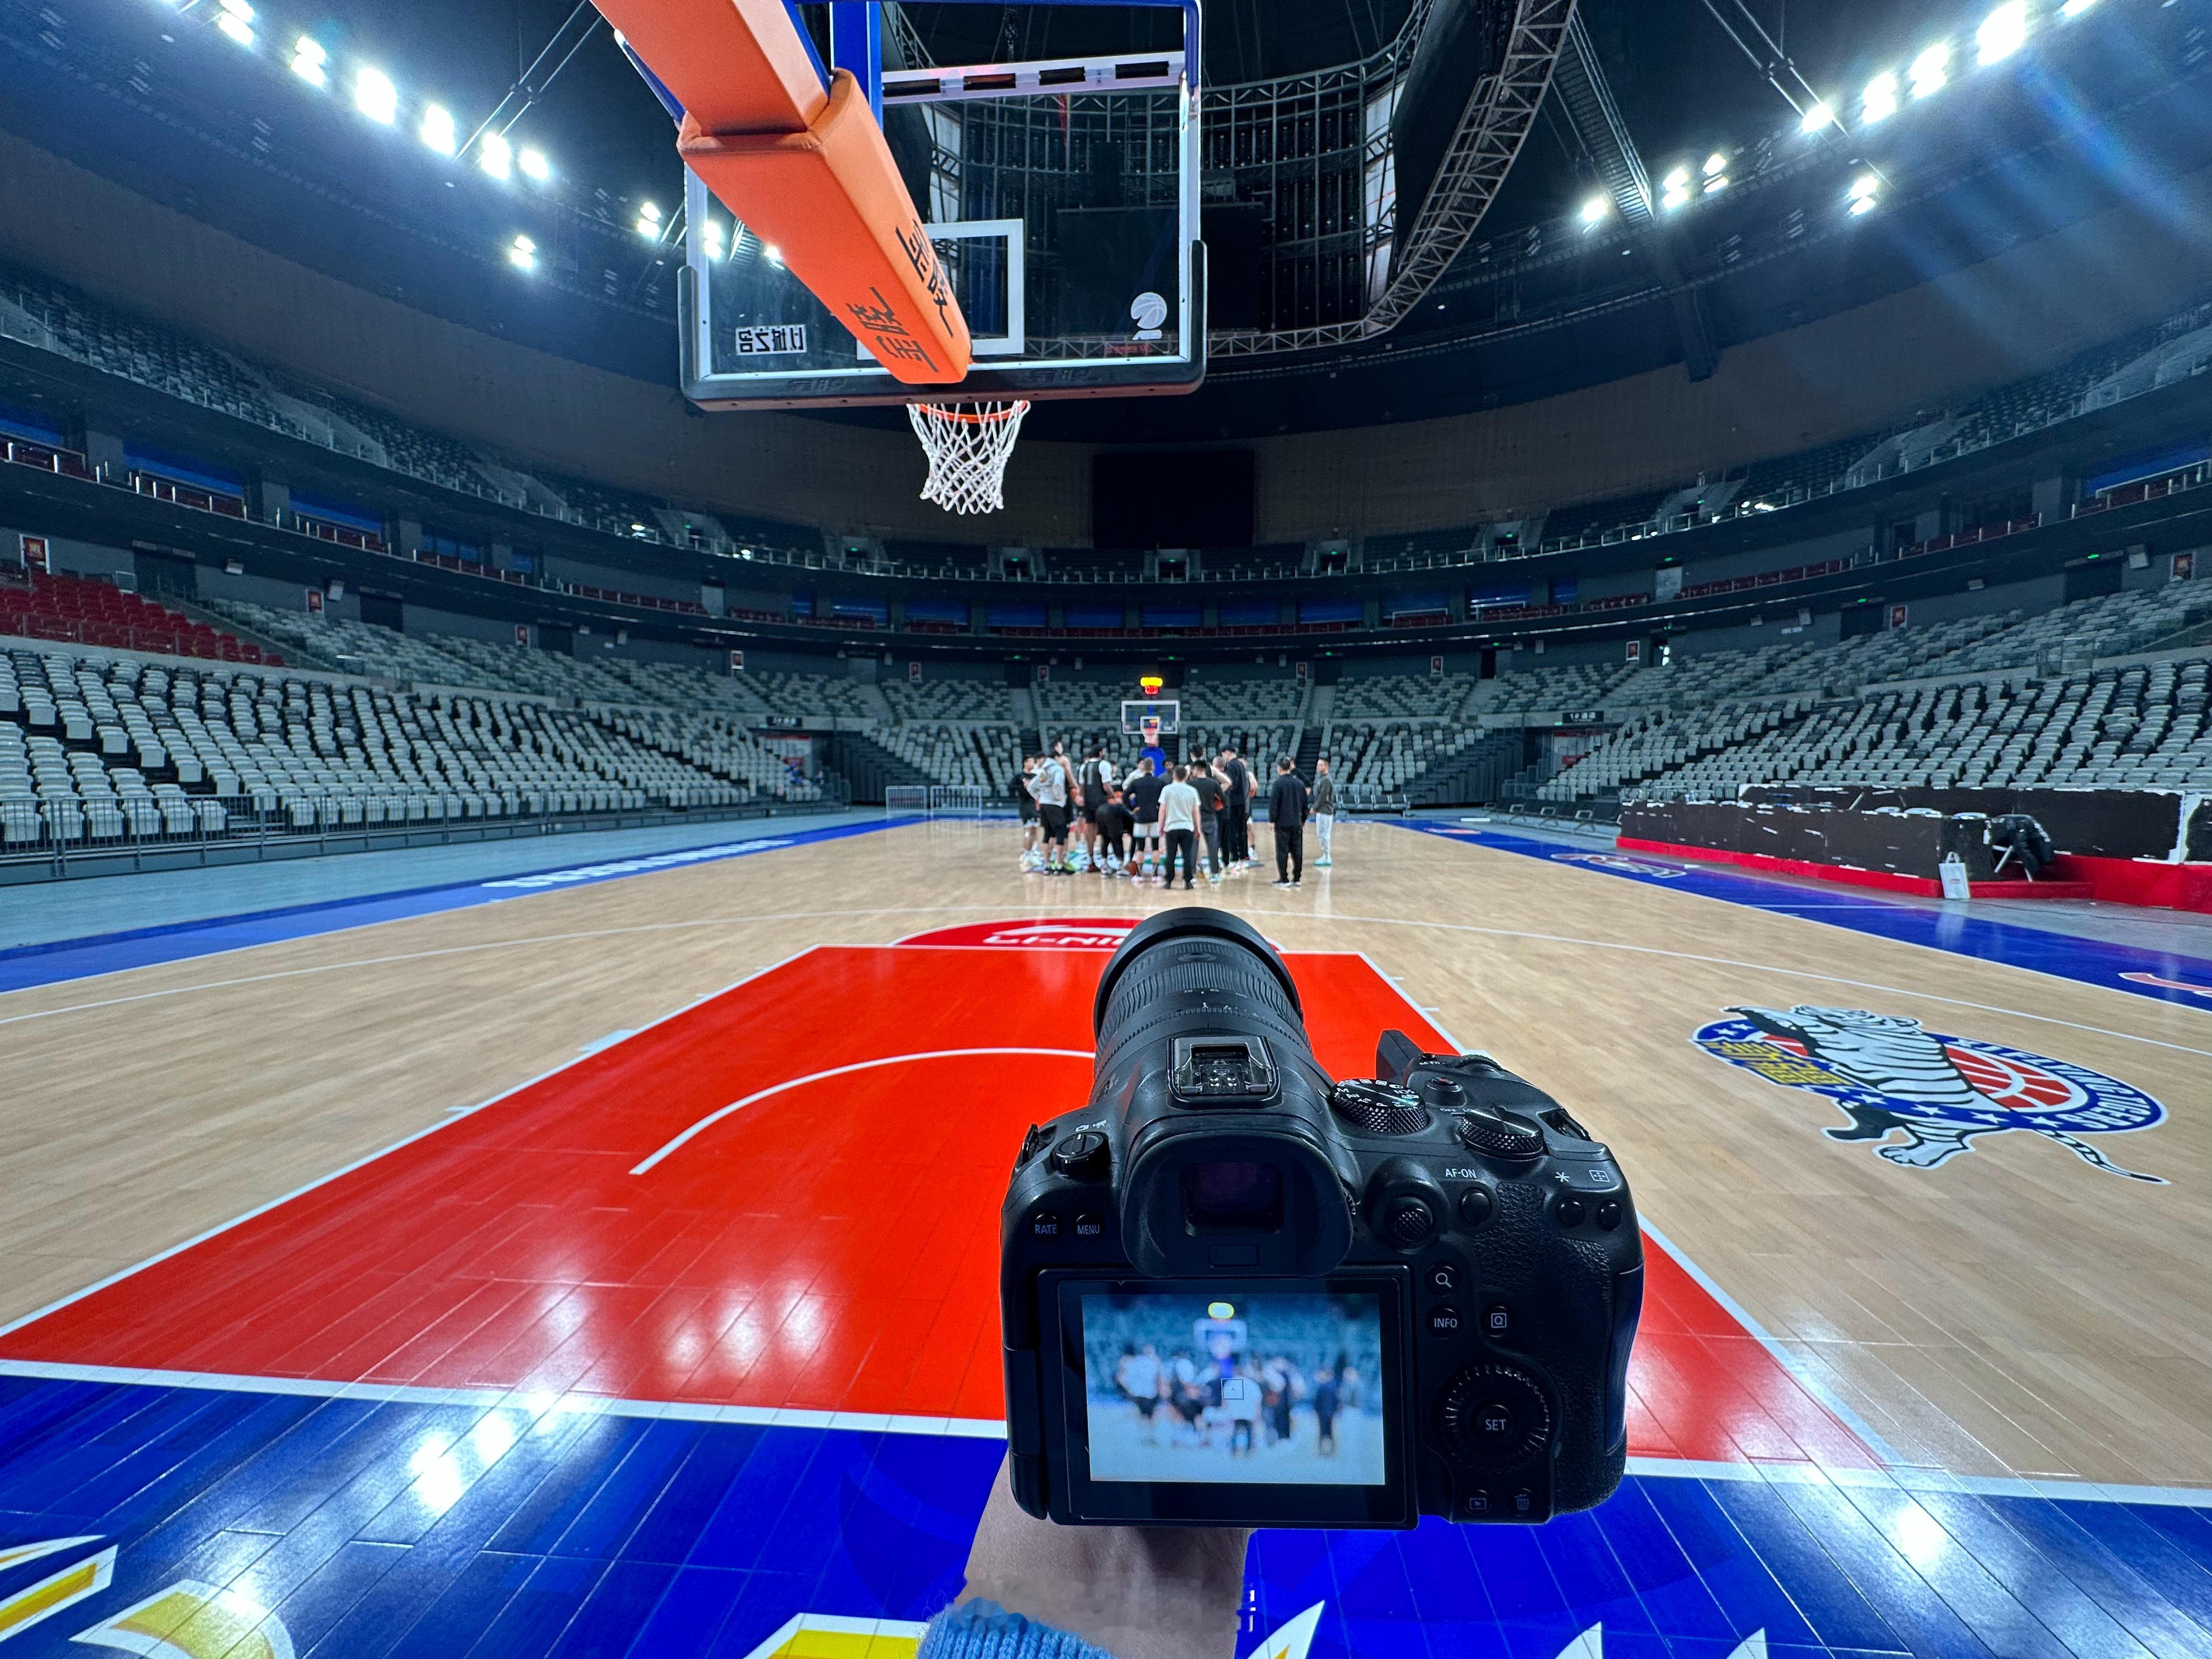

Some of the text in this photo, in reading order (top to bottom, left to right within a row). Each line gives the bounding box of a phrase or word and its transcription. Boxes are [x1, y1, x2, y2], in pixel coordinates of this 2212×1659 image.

[2000, 1051, 2136, 1095] FLYING
[2056, 1093, 2152, 1130] TIGERS
[1444, 1168, 1477, 1179] AF-ON
[1035, 1224, 1058, 1234] RATE
[1077, 1224, 1100, 1234] MENU
[1434, 1318, 1458, 1328] INFO
[1494, 1316, 1503, 1325] Q
[1485, 1418, 1506, 1431] SET
